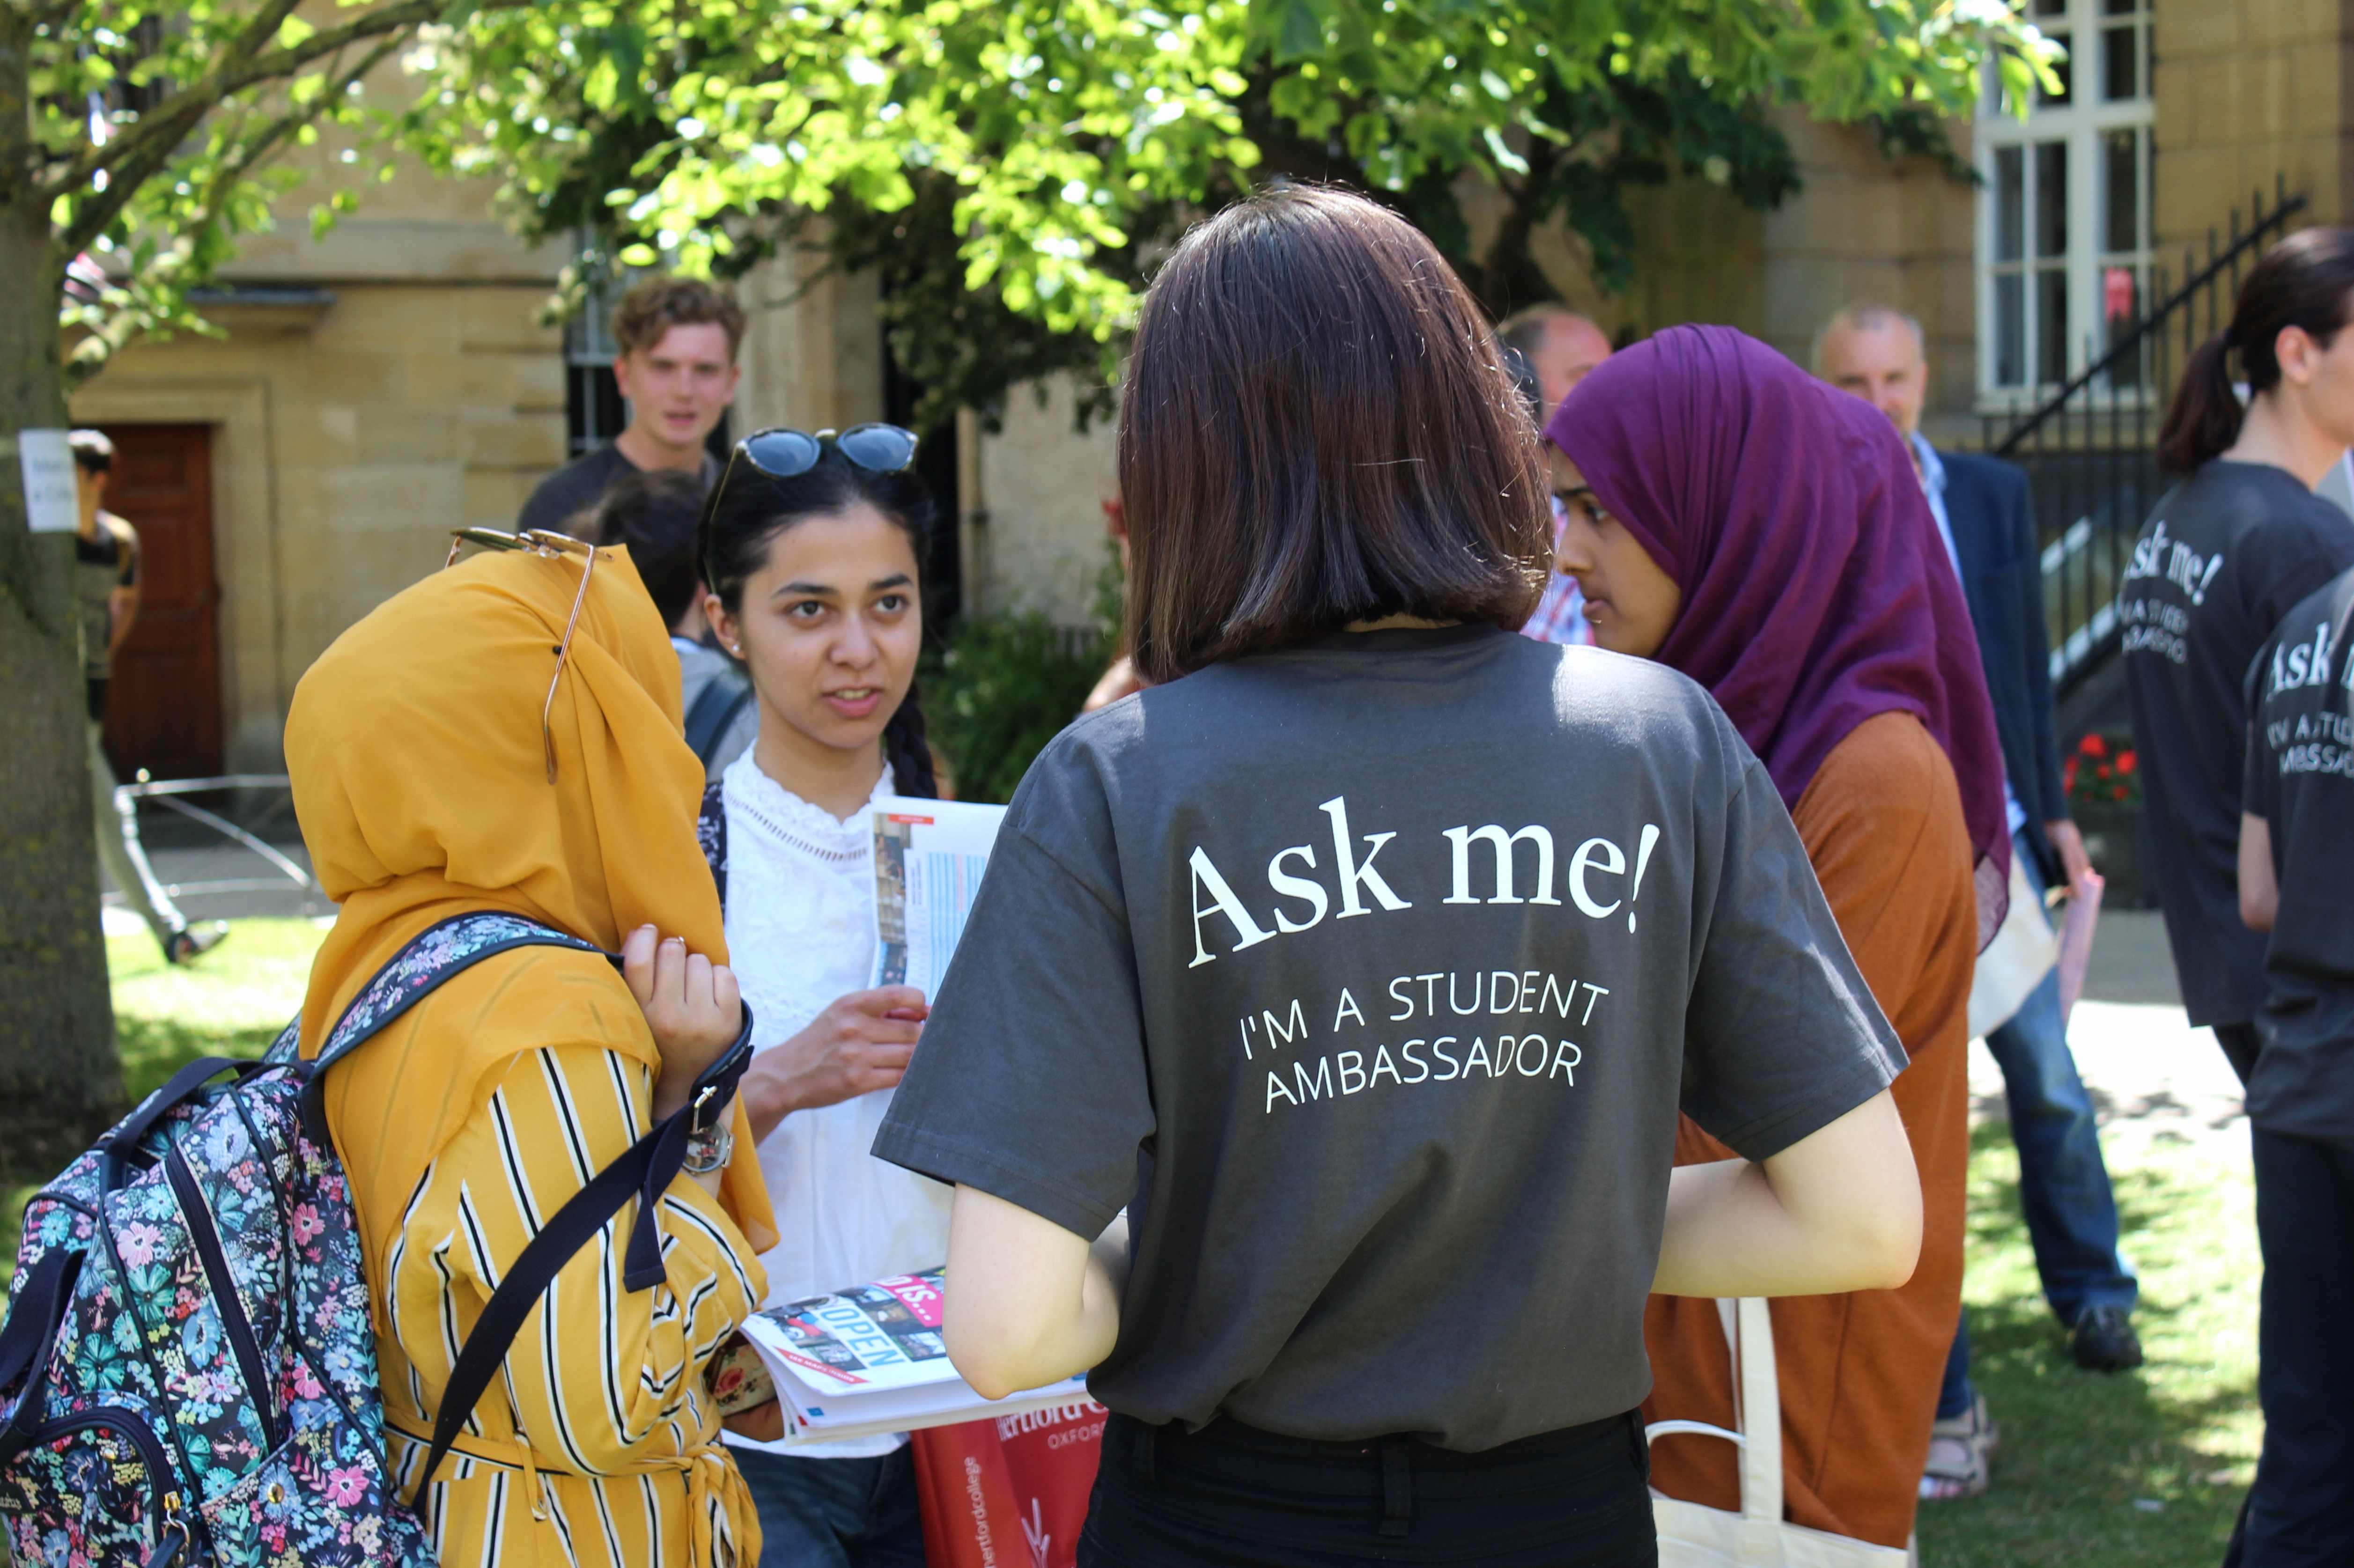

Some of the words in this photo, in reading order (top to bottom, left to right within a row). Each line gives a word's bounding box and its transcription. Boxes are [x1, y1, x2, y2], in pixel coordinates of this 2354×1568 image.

[2123, 520, 2170, 579] sk
[2166, 540, 2224, 606] me!
[1188, 795, 1412, 969] Ask
[1442, 824, 1660, 934] me!
[1240, 999, 1308, 1060] I'M
[1334, 987, 1365, 1032] A
[1389, 971, 1609, 1026] STUDENT
[1266, 1034, 1581, 1114] AMBASSADOR
[819, 1308, 906, 1367] OPEN
